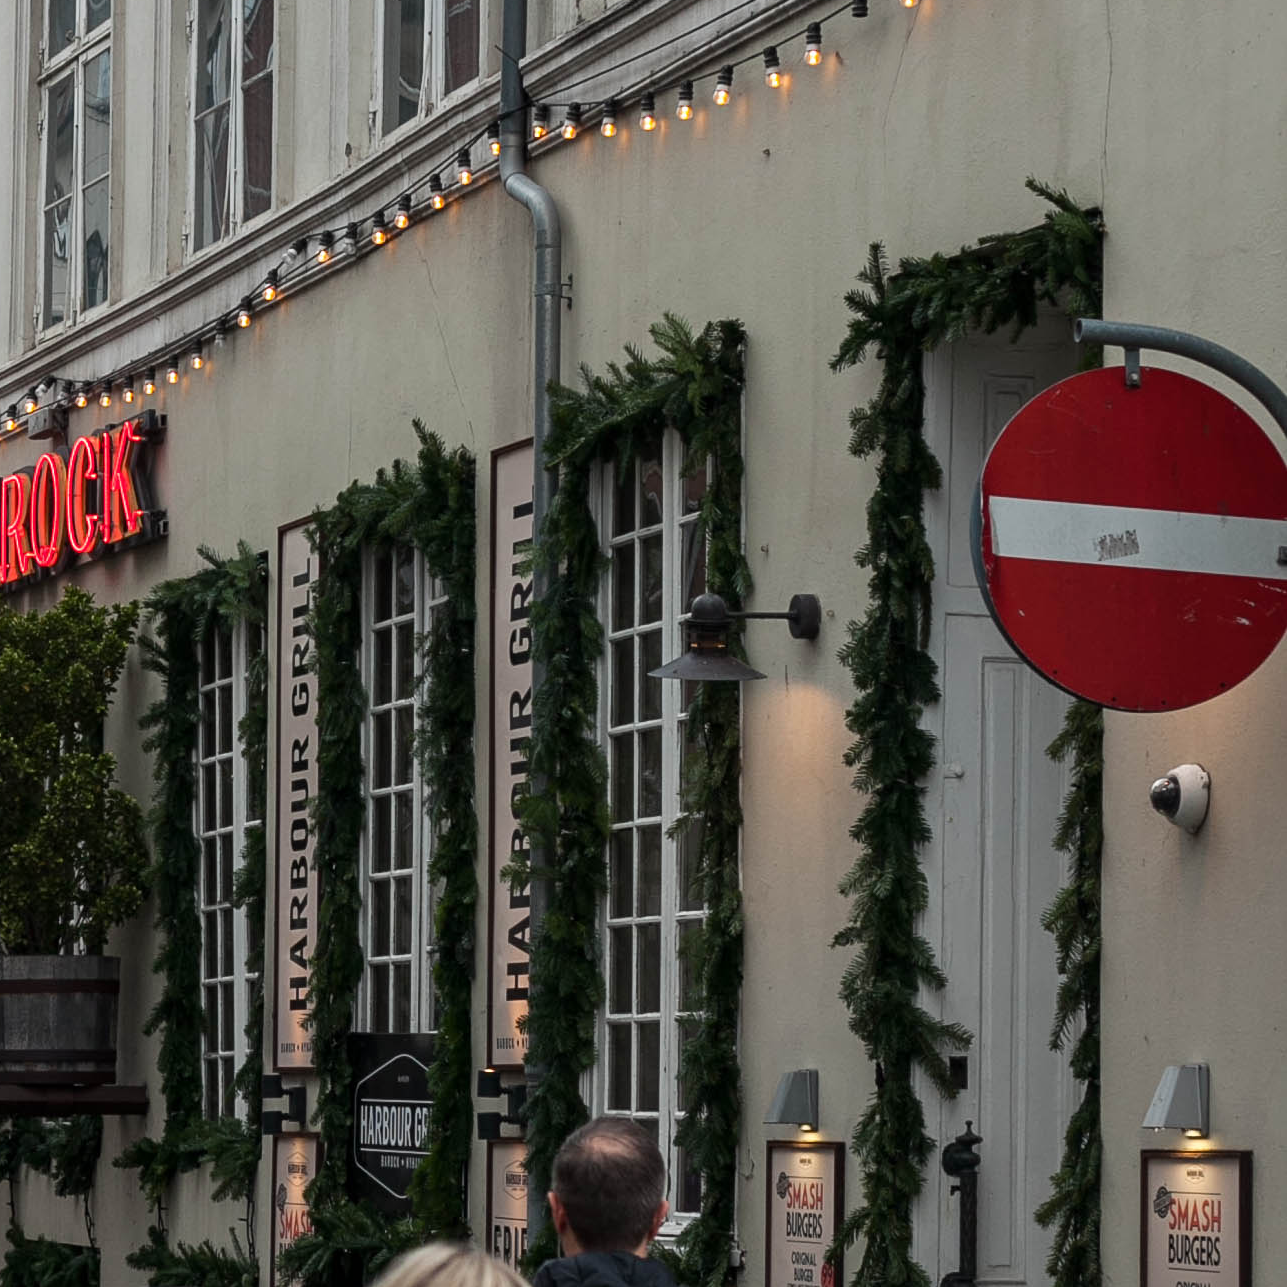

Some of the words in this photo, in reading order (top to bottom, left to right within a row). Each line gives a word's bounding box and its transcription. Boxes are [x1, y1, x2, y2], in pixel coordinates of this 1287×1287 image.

[292, 558, 311, 717] GRILL
[290, 735, 310, 1010] HARBOUR
[360, 1105, 412, 1147] HARBOUR
[414, 1107, 432, 1148] GR
[787, 1182, 824, 1211] SMASH
[786, 1212, 823, 1239] BURGERS
[1168, 1198, 1221, 1233] SMASH
[791, 1251, 817, 1267] ORIGINAL
[1168, 1234, 1221, 1266] BURGERS
[794, 1268, 813, 1282] BURGER
